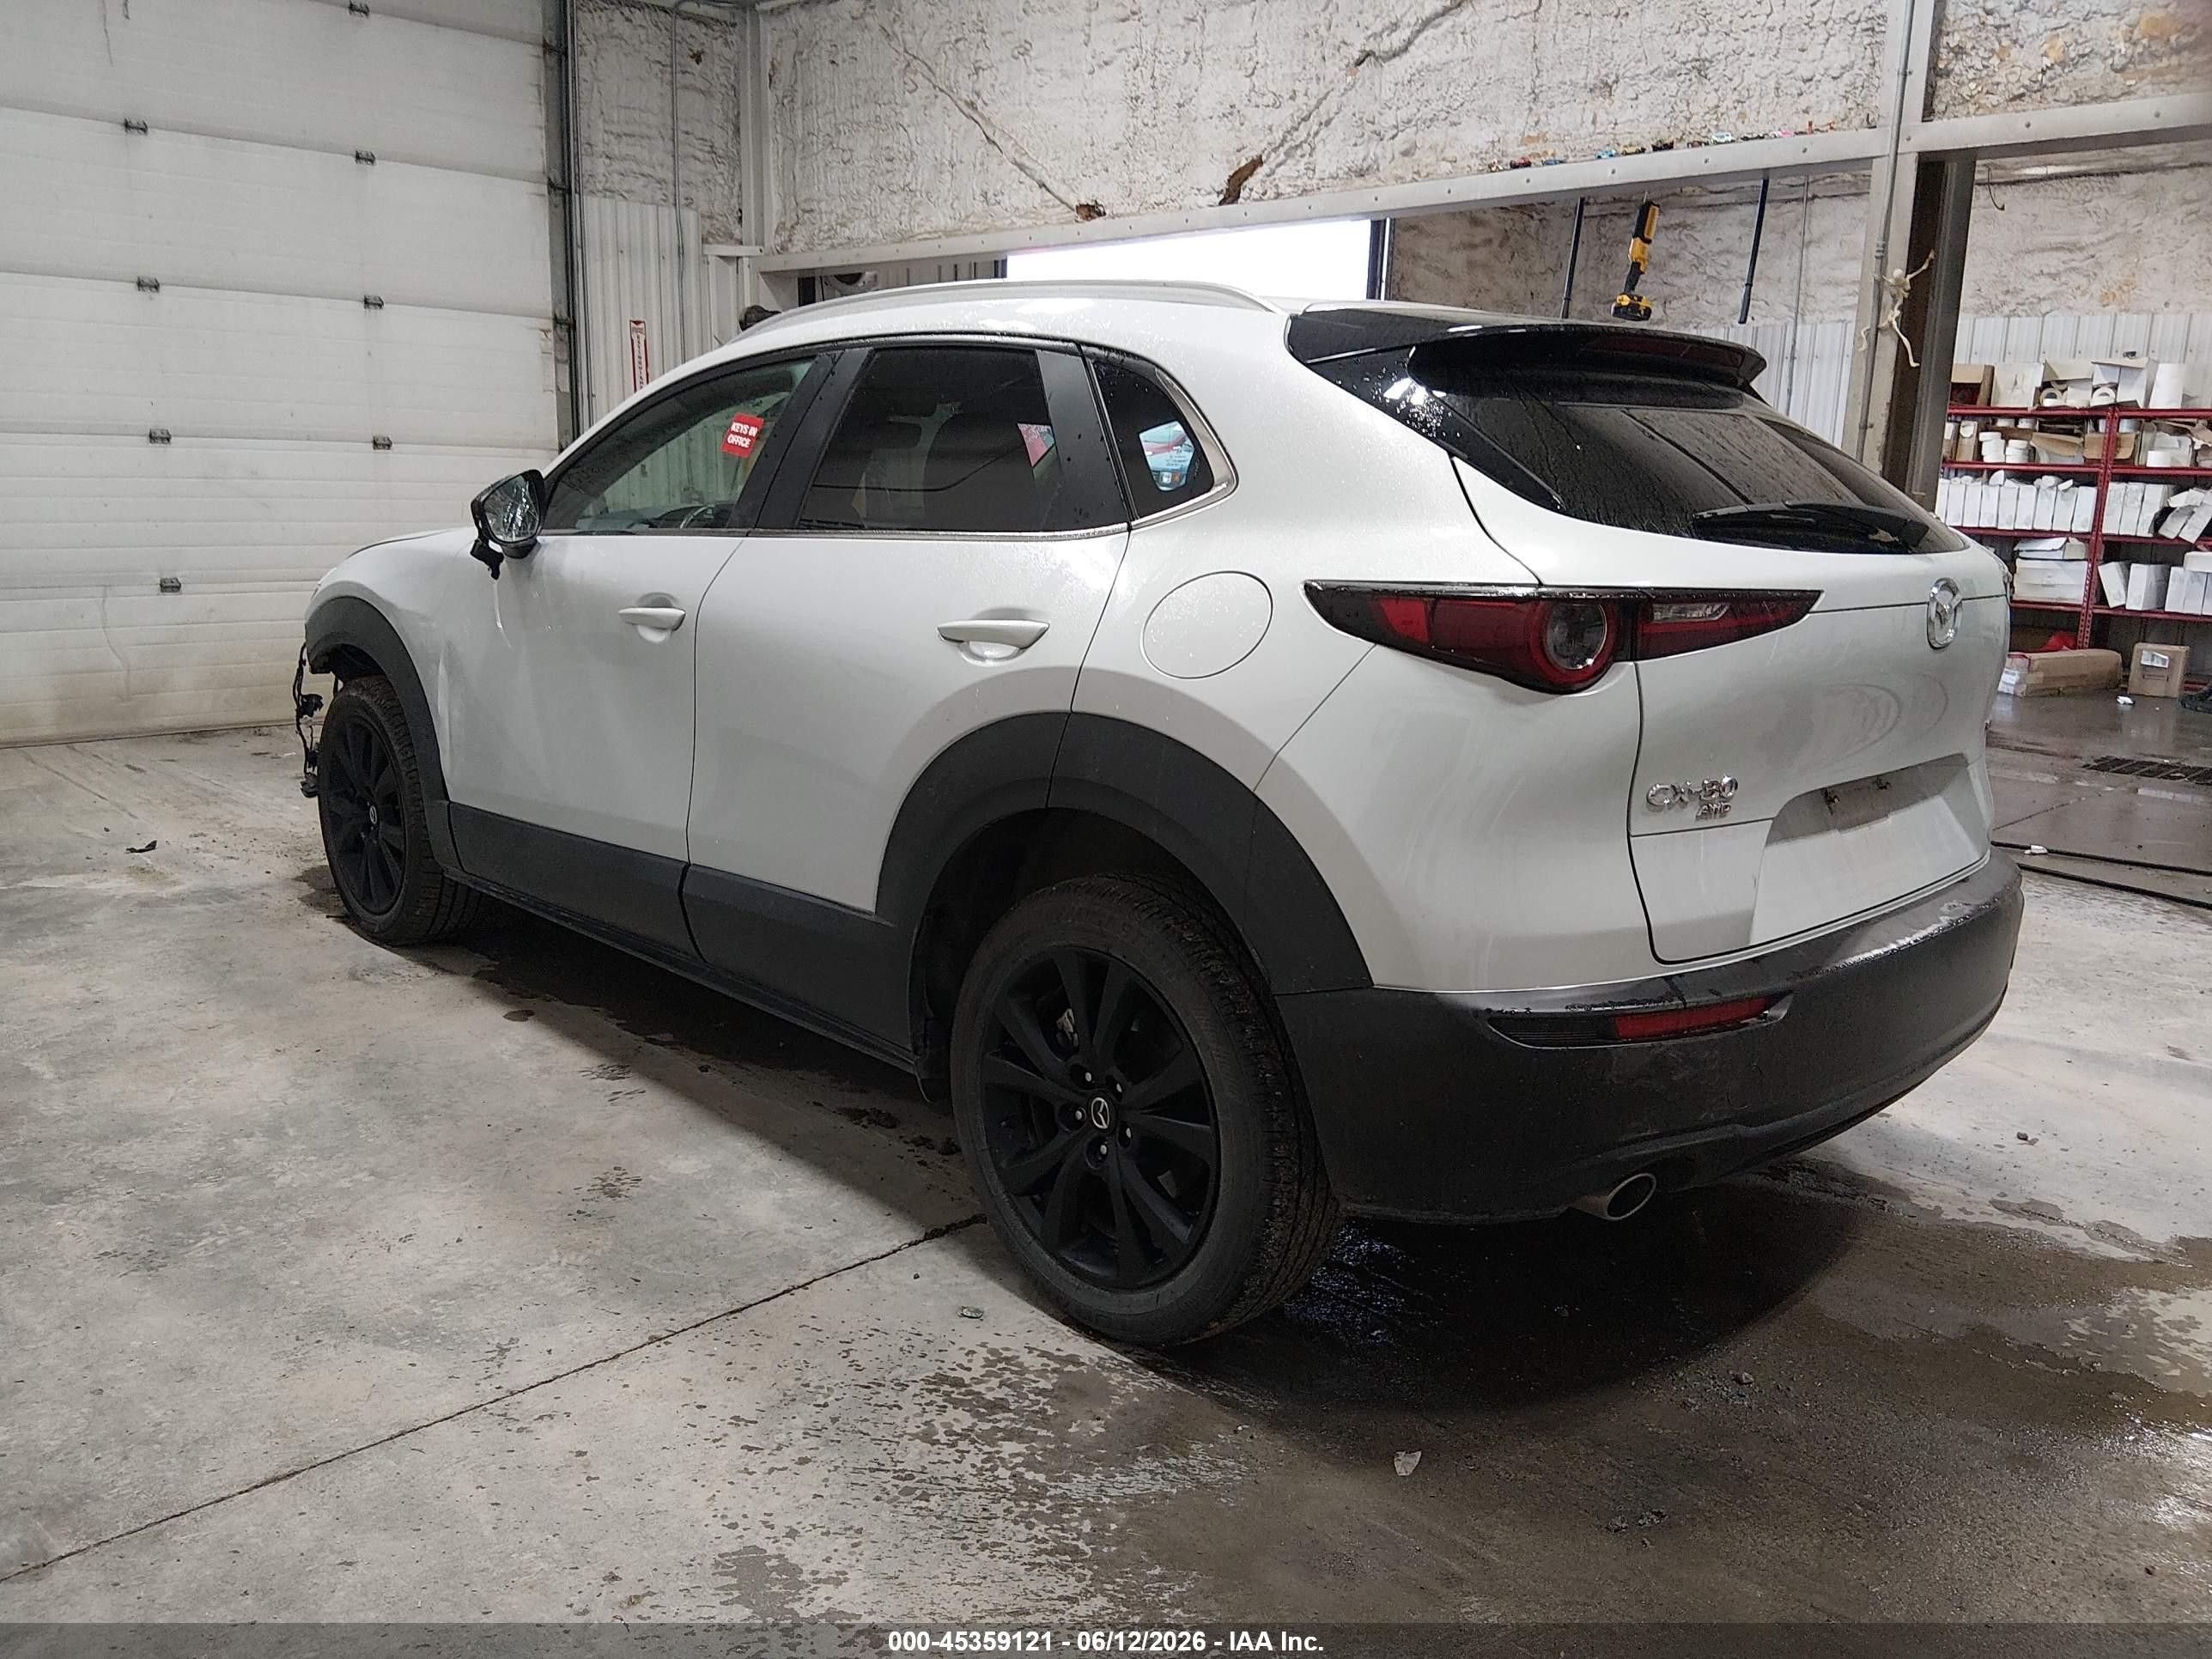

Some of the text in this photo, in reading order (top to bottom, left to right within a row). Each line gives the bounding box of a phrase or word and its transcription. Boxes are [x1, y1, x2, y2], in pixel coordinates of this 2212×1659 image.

[731, 422, 758, 437] KEYS IN
[727, 434, 751, 448] OFFICE
[1647, 774, 1738, 806] CX-30
[1697, 802, 1731, 818] AWD
